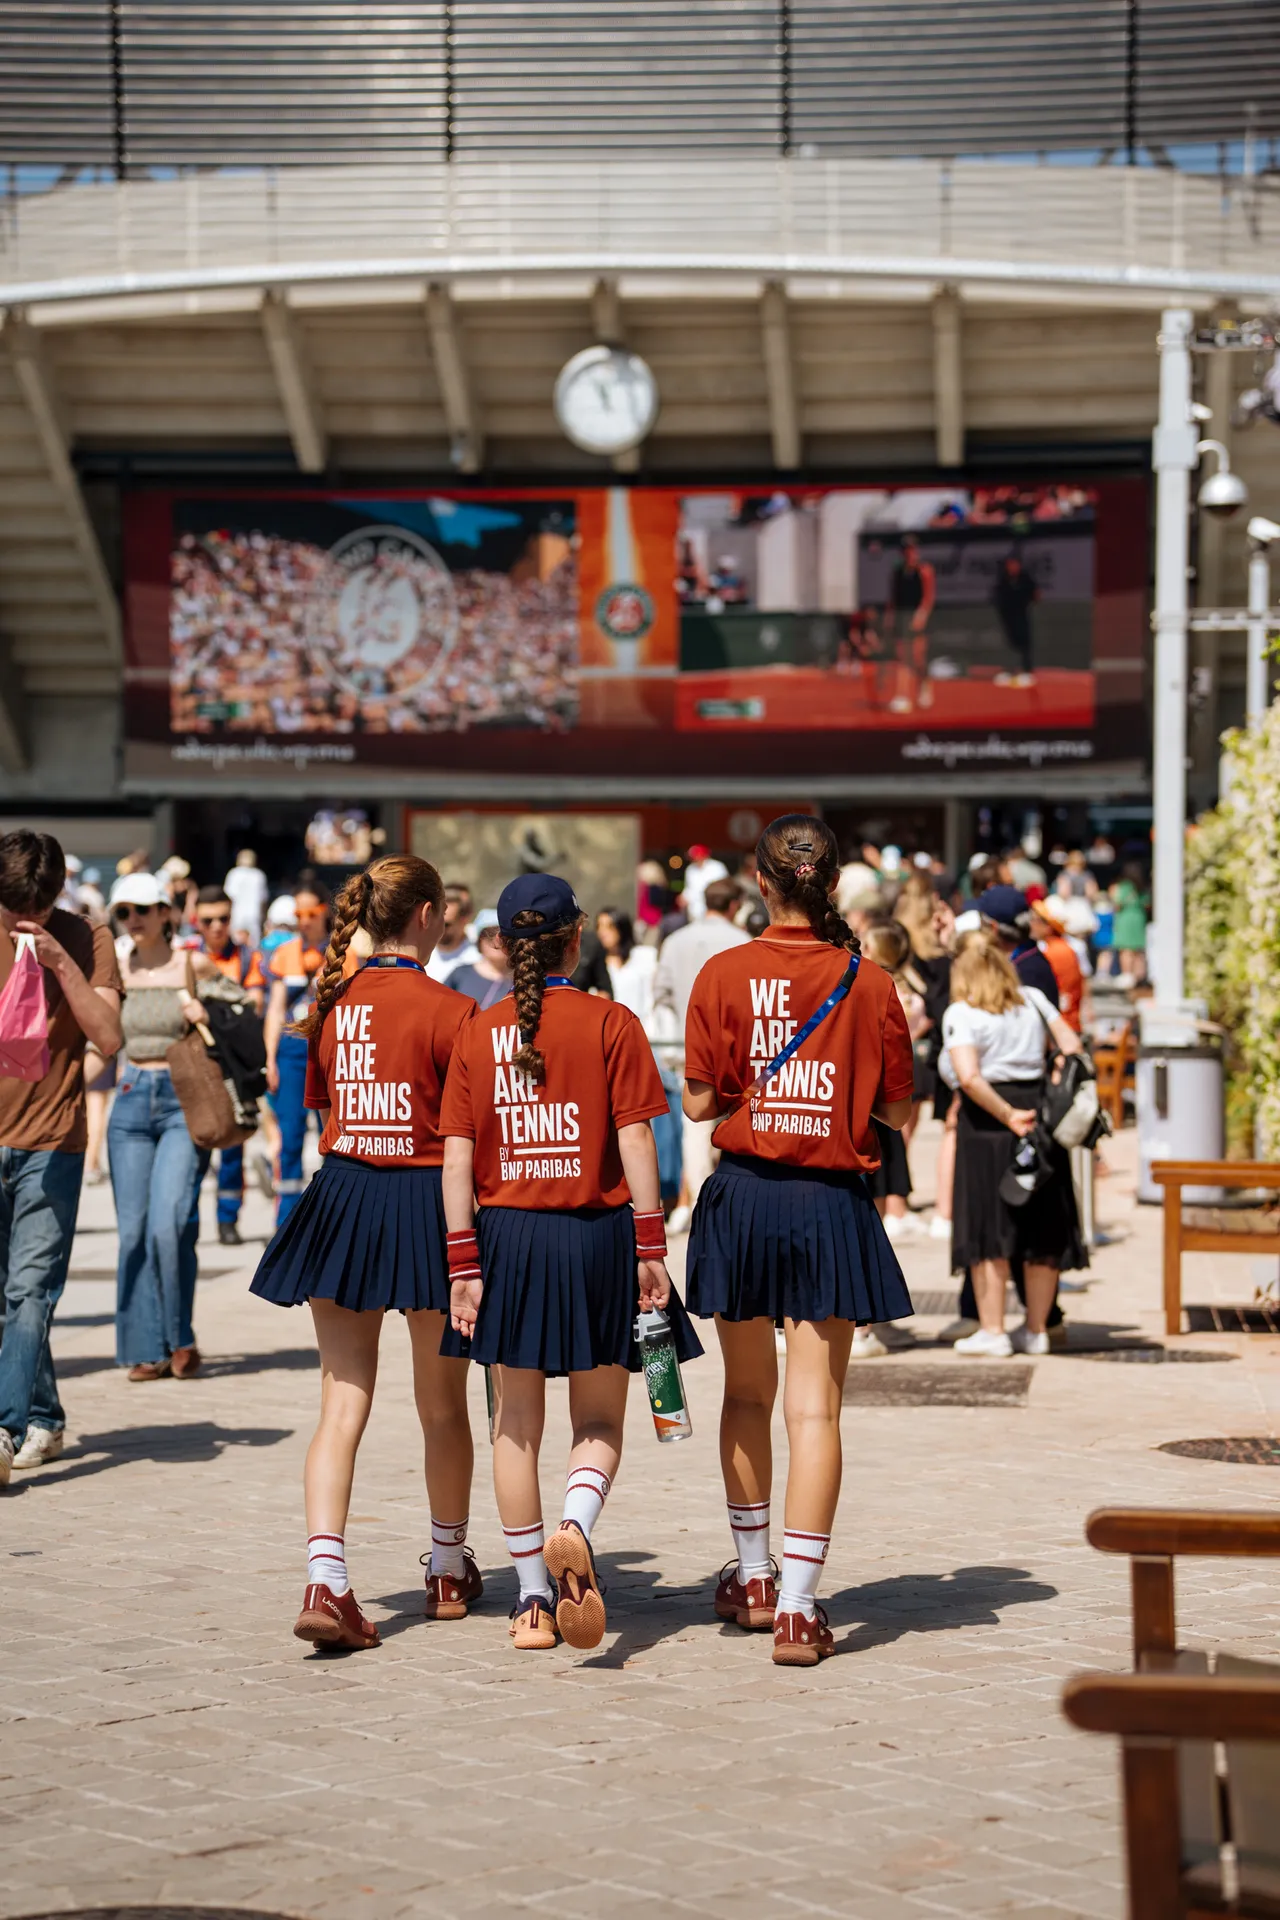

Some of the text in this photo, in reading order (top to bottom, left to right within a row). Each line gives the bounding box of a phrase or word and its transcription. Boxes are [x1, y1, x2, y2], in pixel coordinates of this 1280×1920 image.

[749, 978, 791, 1018] WE
[335, 1005, 374, 1041] WE
[335, 1043, 376, 1081] ARE
[491, 1024, 523, 1064] W
[335, 1082, 412, 1121] TENNIS
[495, 1102, 580, 1144] TENNIS
[752, 1112, 831, 1138] BNP PARIBAS
[331, 1135, 414, 1156] BNP PARIBAS
[499, 1147, 509, 1161] BY
[501, 1157, 582, 1181] BNP PARIBAS
